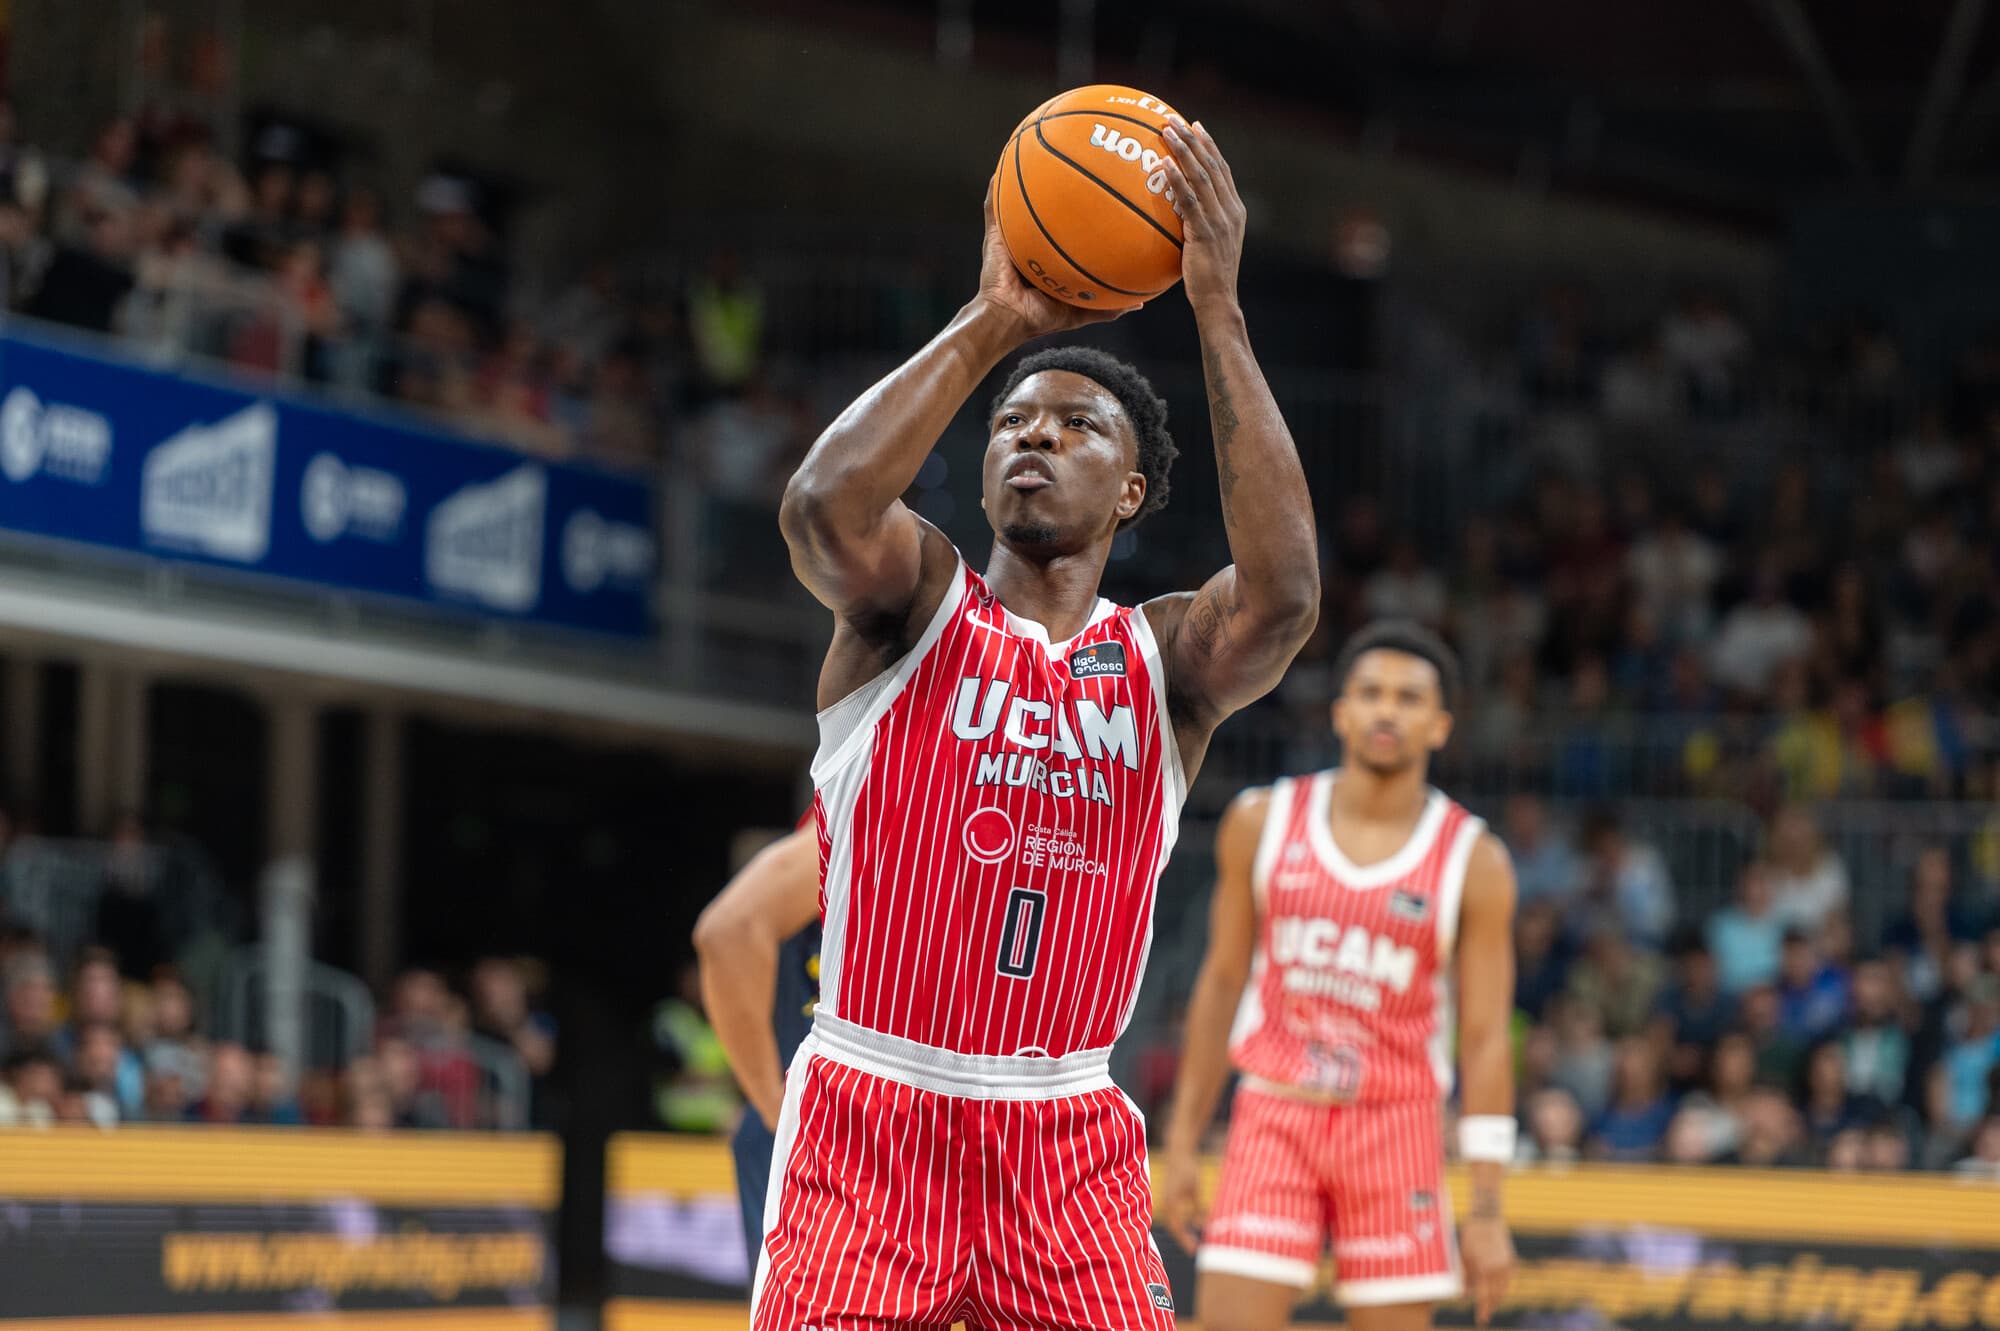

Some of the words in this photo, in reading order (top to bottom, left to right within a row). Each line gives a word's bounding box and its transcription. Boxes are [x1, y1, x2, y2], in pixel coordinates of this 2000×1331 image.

[1088, 122, 1185, 220] lson
[1073, 655, 1097, 667] liga
[1075, 661, 1124, 675] endesa
[951, 676, 1139, 771] UCAM
[974, 751, 1112, 807] MURCIA
[1027, 823, 1052, 835] Costa
[1022, 850, 1046, 868] DE
[1049, 854, 1106, 877] MURCIA
[996, 886, 1048, 981] 0
[1271, 914, 1418, 996] UCAM
